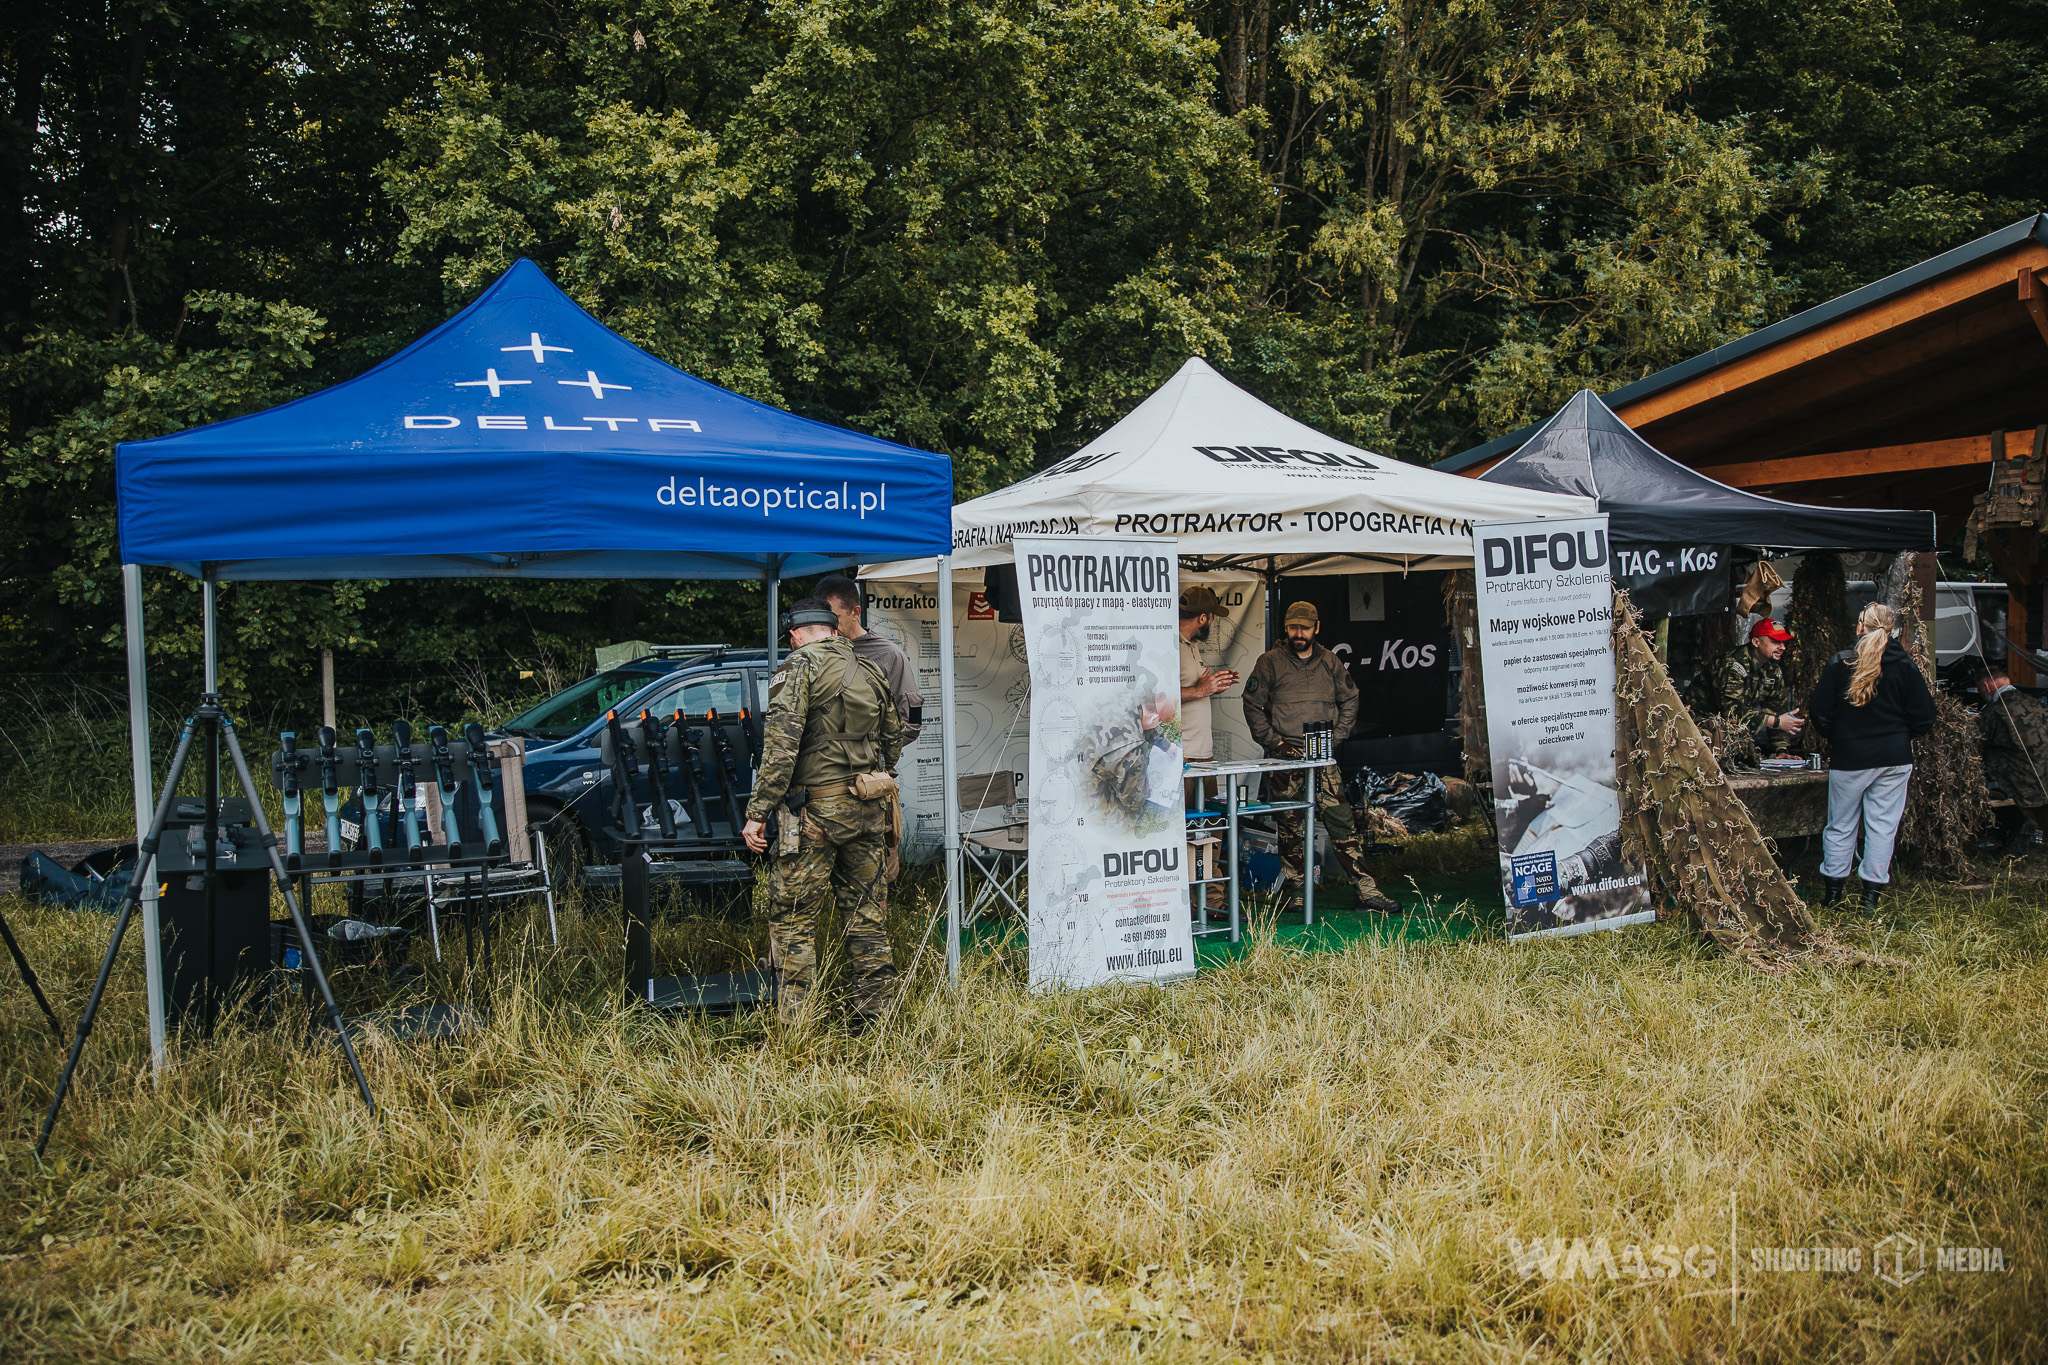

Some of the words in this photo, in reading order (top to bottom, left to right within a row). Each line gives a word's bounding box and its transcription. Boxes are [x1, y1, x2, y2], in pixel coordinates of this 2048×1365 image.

[404, 414, 703, 433] DELTA
[1192, 446, 1380, 470] DIFOU
[656, 476, 887, 521] deltaoptical.pl
[1114, 512, 1283, 533] PROTRAKTOR
[1304, 511, 1445, 535] TOPOGRAFIA
[1482, 529, 1608, 578] DIFOU
[1617, 549, 1661, 577] TAC
[1680, 547, 1719, 573] Kos
[1027, 554, 1171, 593] PROTRAKTOR
[1486, 576, 1553, 594] Protraktory
[1556, 570, 1611, 588] Szkolenia
[1032, 595, 1064, 611] przyrząd
[1066, 596, 1074, 608] do
[1075, 597, 1094, 609] pracy
[1096, 597, 1101, 607] z
[1102, 597, 1125, 612] mapą
[1131, 596, 1172, 609] elastyczny
[1225, 592, 1243, 606] LD
[1490, 618, 1520, 635] Mapy
[1522, 612, 1576, 631] wojskowe
[1087, 633, 1109, 641] formacji
[1088, 643, 1111, 651] jednostki
[1112, 643, 1137, 651] wojskowej
[1378, 638, 1437, 671] Kos
[1503, 658, 1523, 667] papier
[1523, 655, 1531, 663] do
[1532, 651, 1568, 662] zastosowań
[1569, 646, 1607, 659] specjalnych
[1076, 677, 1084, 686] V3
[1516, 682, 1549, 694] możliwość
[1550, 679, 1578, 691] konwersji
[1579, 677, 1597, 688] mapy
[1518, 715, 1539, 726] ofercie
[1540, 710, 1588, 724] specjalistyczne
[1589, 707, 1610, 719] mapy:
[1545, 724, 1559, 734] typu
[1560, 722, 1574, 732] OCR
[1538, 733, 1574, 746] ucieczkowe
[1575, 731, 1585, 741] UV
[1077, 818, 1085, 826] V5
[1103, 847, 1179, 878] DIFOU
[1515, 862, 1552, 877] NCAGE
[1105, 877, 1146, 889] Protraktory
[1147, 874, 1180, 885] Szkolenia
[1536, 875, 1552, 883] NATO
[1571, 874, 1641, 897] www.difou.eu
[1536, 886, 1554, 894] OTAN
[1115, 913, 1170, 928] contact@difou.eu
[1132, 932, 1142, 942] 691
[1144, 930, 1155, 941] 498
[1107, 947, 1182, 972] www.difou.eu
